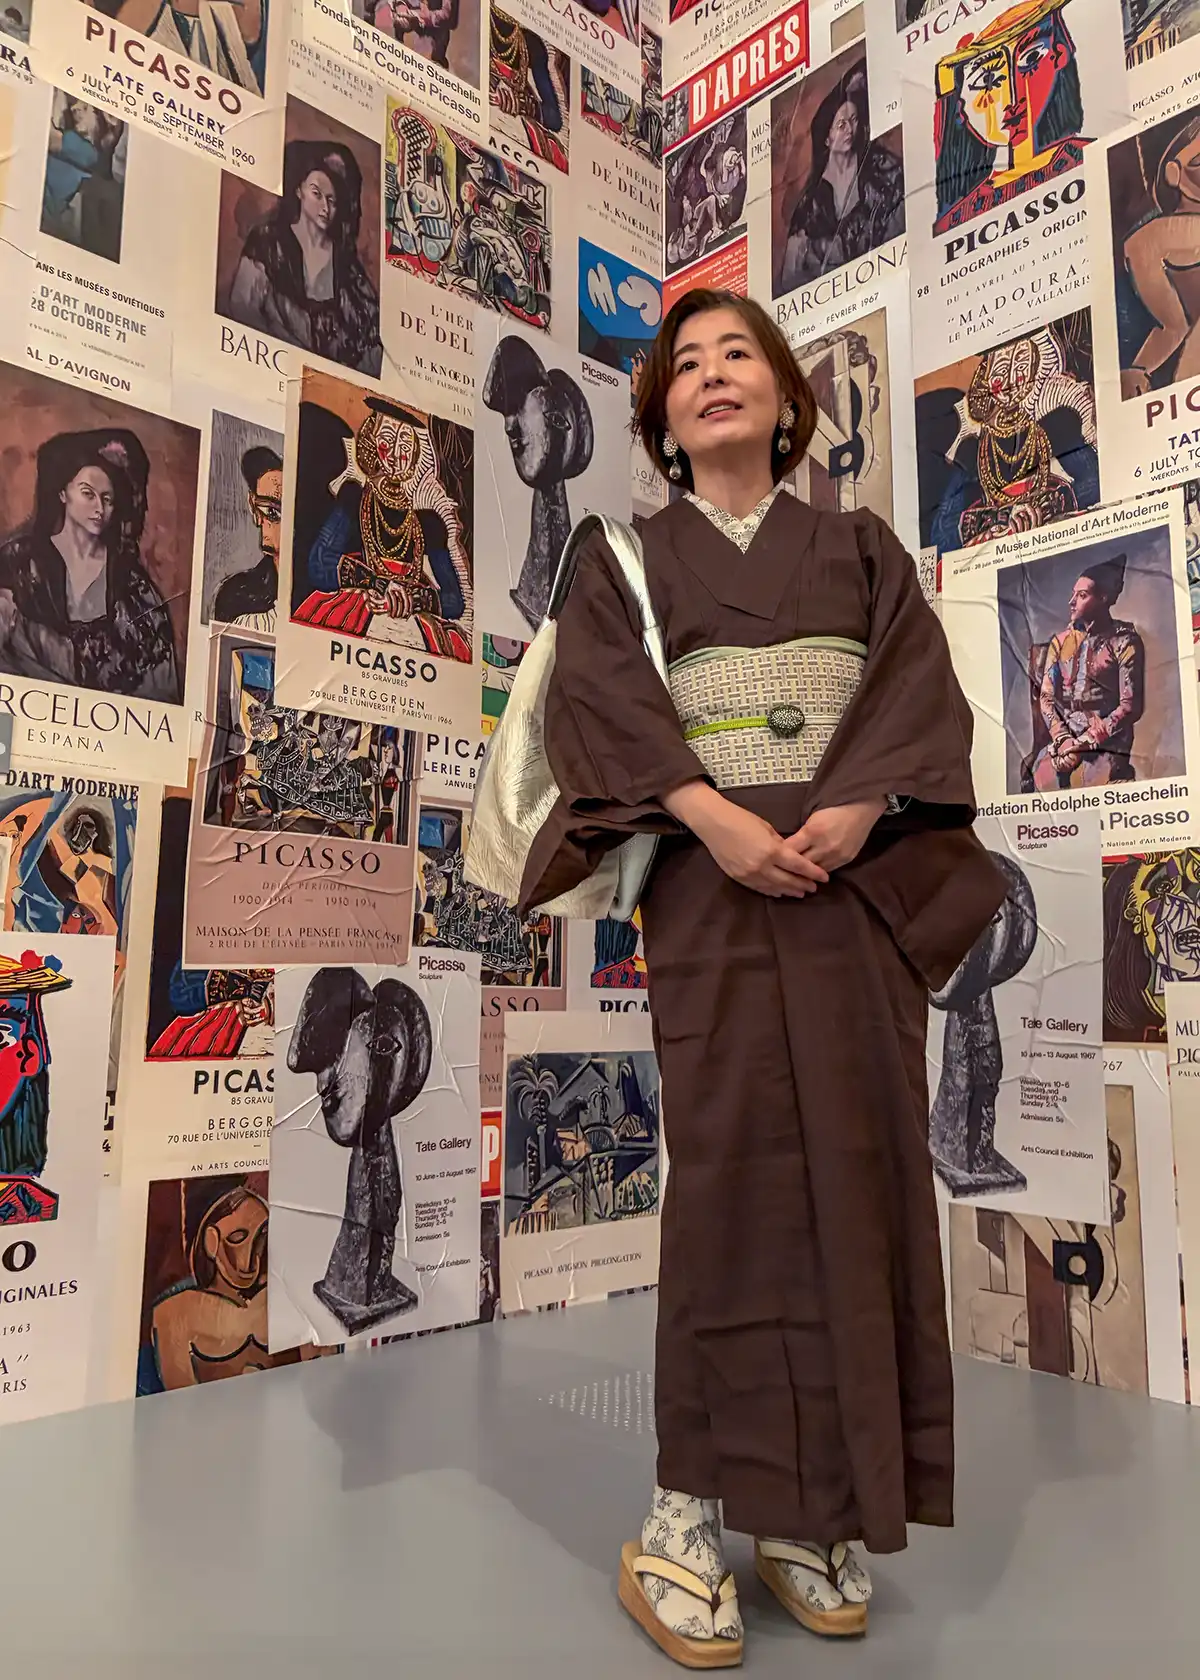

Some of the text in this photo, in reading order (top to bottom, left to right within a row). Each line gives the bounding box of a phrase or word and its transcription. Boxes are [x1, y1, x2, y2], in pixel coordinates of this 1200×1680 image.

[85, 16, 242, 115] PICASSO
[372, 31, 424, 72] Rodolphe
[426, 65, 481, 107] Staechelin
[353, 35, 371, 59] De
[374, 51, 416, 87] Corot
[418, 76, 426, 92] à
[429, 82, 481, 123] Picasso
[81, 86, 119, 109] WEEKDAYS
[102, 65, 227, 136] TATE GALLERY
[1132, 84, 1174, 112] PICASSO
[66, 66, 256, 167] 6 JULY TO 18 SEPTEMBER 1960
[1143, 103, 1181, 126] AN ARTS
[592, 160, 612, 185] DE
[944, 179, 1086, 265] PICASSO
[940, 236, 1030, 288] LINOGRAPHIES
[946, 295, 960, 306] DU
[1011, 264, 1025, 276] AU
[1042, 247, 1063, 262] MAI
[36, 261, 165, 318] ANS LES MUSÉES SOVIÉTIQUES
[31, 297, 45, 312] 28
[51, 305, 111, 338] OCTOBRE
[115, 330, 127, 343] 71
[40, 285, 79, 309] D'ART
[84, 302, 147, 337] MODERNE
[798, 324, 816, 337] 1966
[860, 292, 879, 308] 1967
[949, 275, 1091, 344] LE PLAN VALLAURIS
[400, 310, 474, 357] DE DEL
[221, 325, 289, 377] BARC
[26, 346, 43, 362] AL
[49, 354, 131, 392] D'AVIGNON
[582, 361, 619, 388] Picasso
[1134, 453, 1179, 478] 6 JULY
[1150, 465, 1189, 481] WEEKDAYS
[1032, 523, 1079, 547] National
[1081, 515, 1110, 533] d'Art
[1112, 501, 1169, 523] Moderne
[331, 640, 437, 682] PICASSO
[361, 671, 408, 688] 85 GRAVURES
[310, 689, 453, 725] 70 RUE DE L'UNIVERSITÉ 1966
[343, 684, 426, 710] BERGGRUEN
[27, 728, 104, 753] ESPAÑA
[423, 761, 461, 777] LERIE
[5, 769, 139, 801] D'ART MODERNE
[1032, 794, 1100, 814] Rodolphe
[1104, 784, 1188, 805] Staechelin
[1017, 824, 1079, 841] Picasso
[1109, 810, 1190, 830] Picasso
[1017, 842, 1047, 851] Sculpture
[1107, 840, 1136, 848] National
[1160, 835, 1191, 843] Moderne
[233, 841, 380, 874] PICASSO
[195, 926, 402, 945] MAISON DE LA PENSÉE FRANÇASE
[218, 939, 237, 948] RUE
[419, 956, 465, 972] Picasso
[1046, 1018, 1088, 1034] Gallery
[1055, 1052, 1078, 1060] August
[194, 1068, 274, 1095] PICAS
[231, 1096, 273, 1105] 85 GRAVU
[208, 1116, 273, 1130] BERGGR
[1020, 1113, 1053, 1123] Admission
[168, 1128, 271, 1144] 70 RUE DE L'UNIVERSITÉ
[416, 1137, 472, 1153] Tate Gallery
[209, 1162, 228, 1170] ARTS
[234, 1159, 268, 1168] COUNCIL
[1021, 1145, 1093, 1160] Arts Council Exhibition
[446, 1169, 463, 1178] August
[415, 1232, 441, 1242] Admission
[524, 1266, 554, 1280] PICASSO
[3, 1323, 31, 1336] 1963
